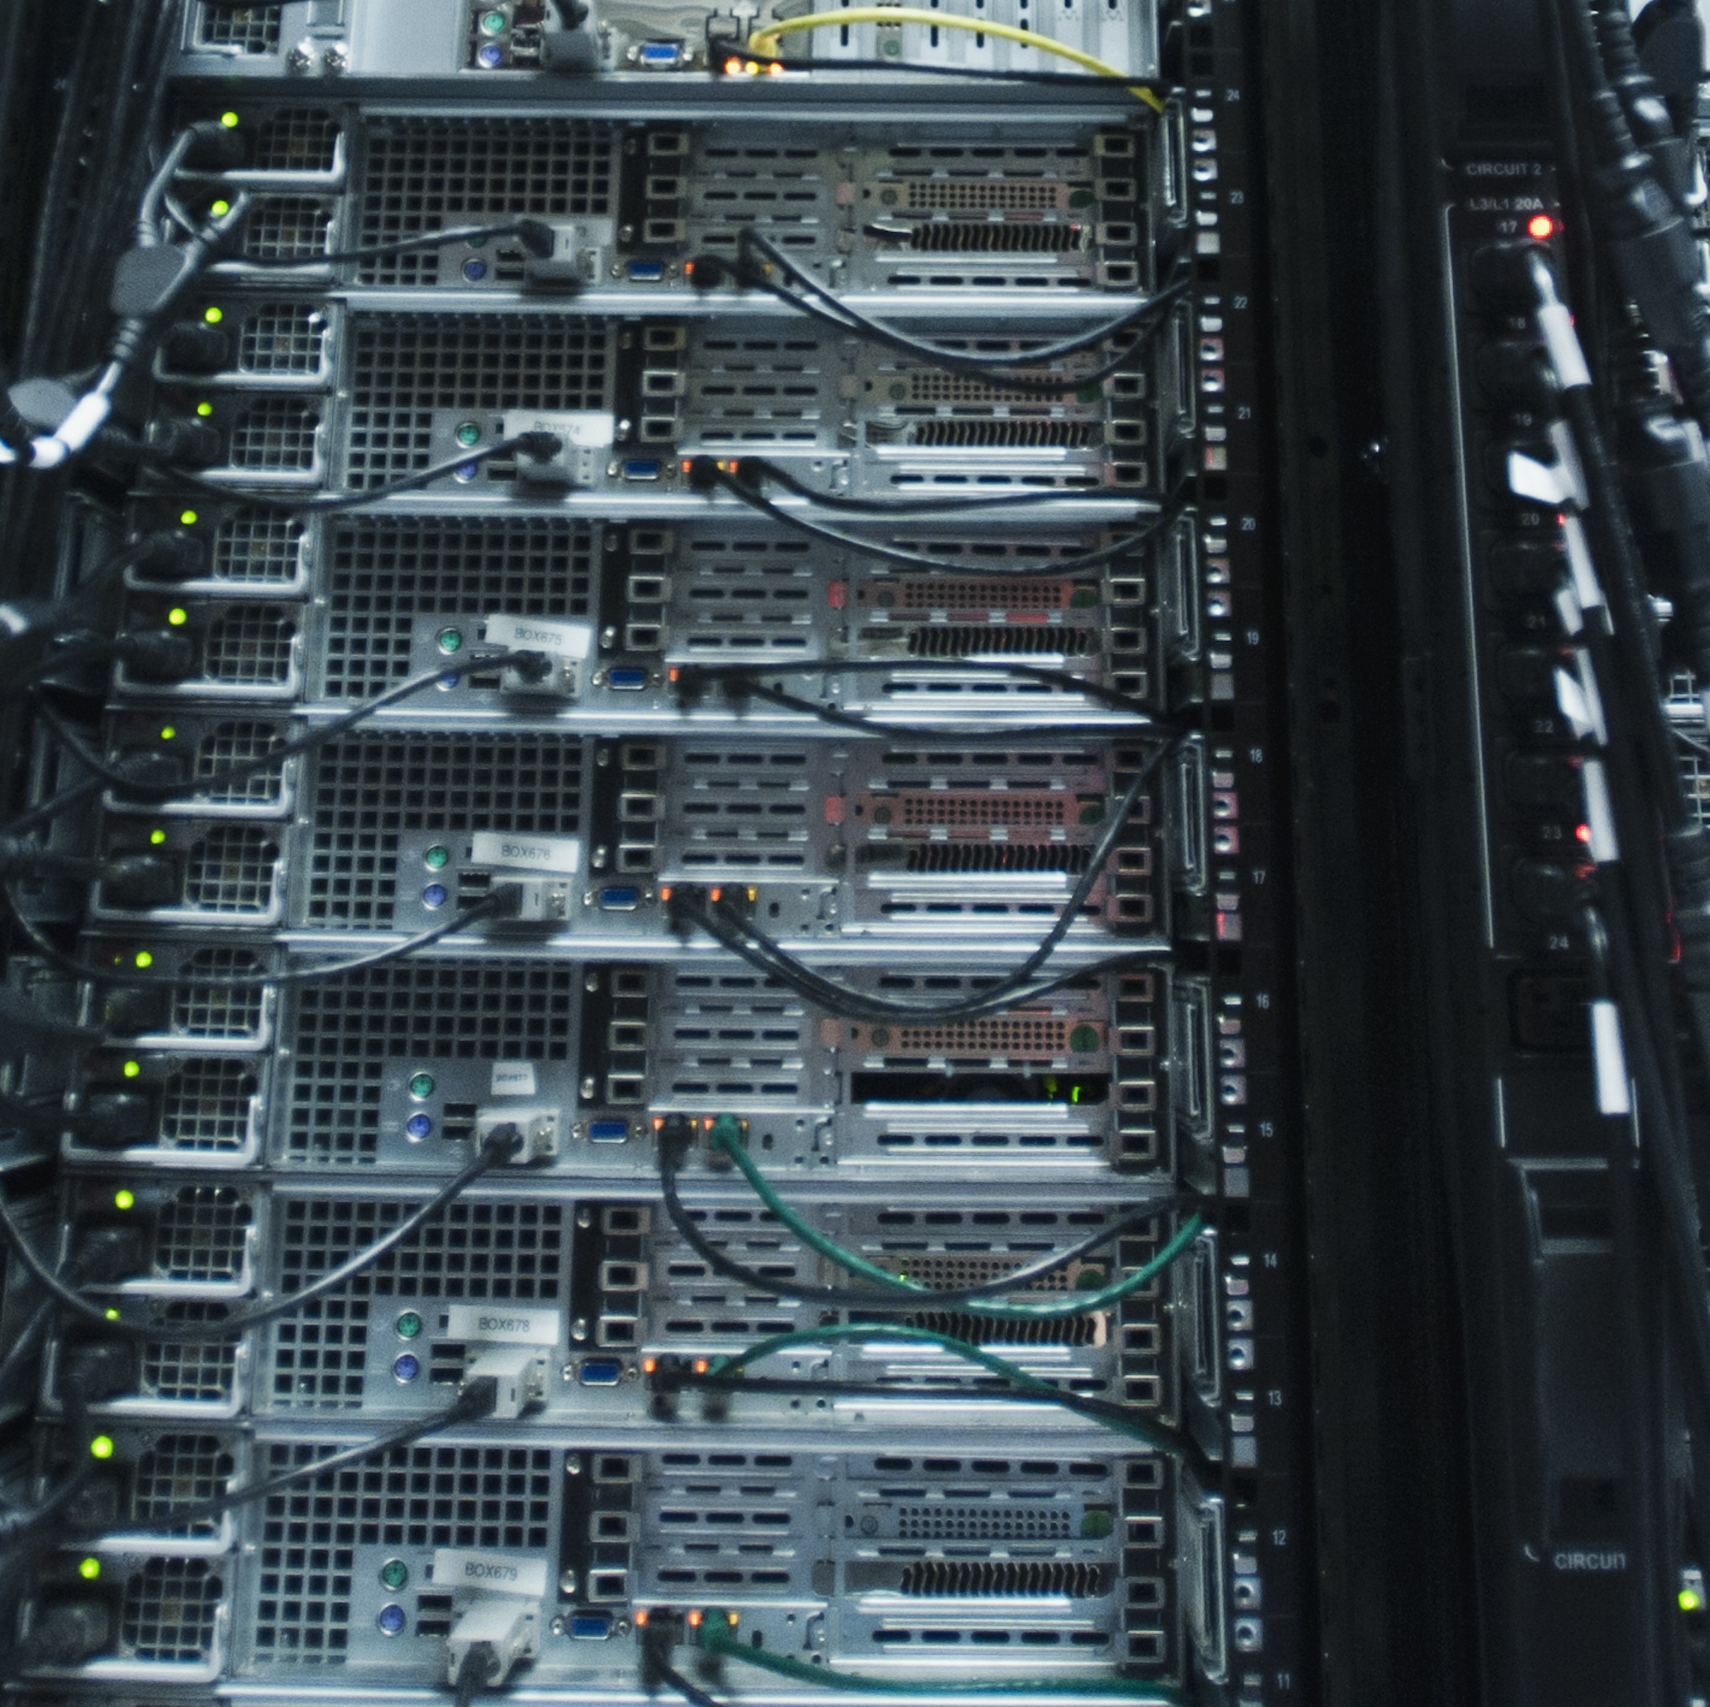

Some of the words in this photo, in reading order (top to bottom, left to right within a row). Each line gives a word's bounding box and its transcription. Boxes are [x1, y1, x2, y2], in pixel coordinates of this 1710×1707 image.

[1226, 89, 1240, 102] 24
[1466, 162, 1529, 175] CIRCUIT
[1533, 162, 1542, 175] 2
[1230, 190, 1244, 205] 23
[1470, 197, 1509, 211] L3/L1
[1514, 197, 1544, 211] 20A
[1500, 220, 1518, 233] 17
[1234, 295, 1248, 309] 22
[1237, 406, 1251, 420] 21
[1241, 517, 1256, 531] 20
[1521, 512, 1540, 526] 20
[1528, 614, 1546, 629] 21
[513, 627, 563, 646] BOX675
[1246, 631, 1260, 646] 19
[1535, 718, 1554, 734] 22
[1249, 748, 1263, 764] 18
[1542, 824, 1563, 841] 23
[1253, 869, 1266, 884] 17
[1549, 935, 1570, 951] 24
[1256, 994, 1270, 1010] 16
[1260, 1122, 1274, 1138] 15
[1264, 1253, 1277, 1268] 14
[478, 1316, 531, 1333] BOX678
[1267, 1389, 1282, 1406] 13
[1272, 1529, 1287, 1546] 12
[464, 1560, 518, 1581] BOX679
[1277, 1672, 1291, 1690] 11
